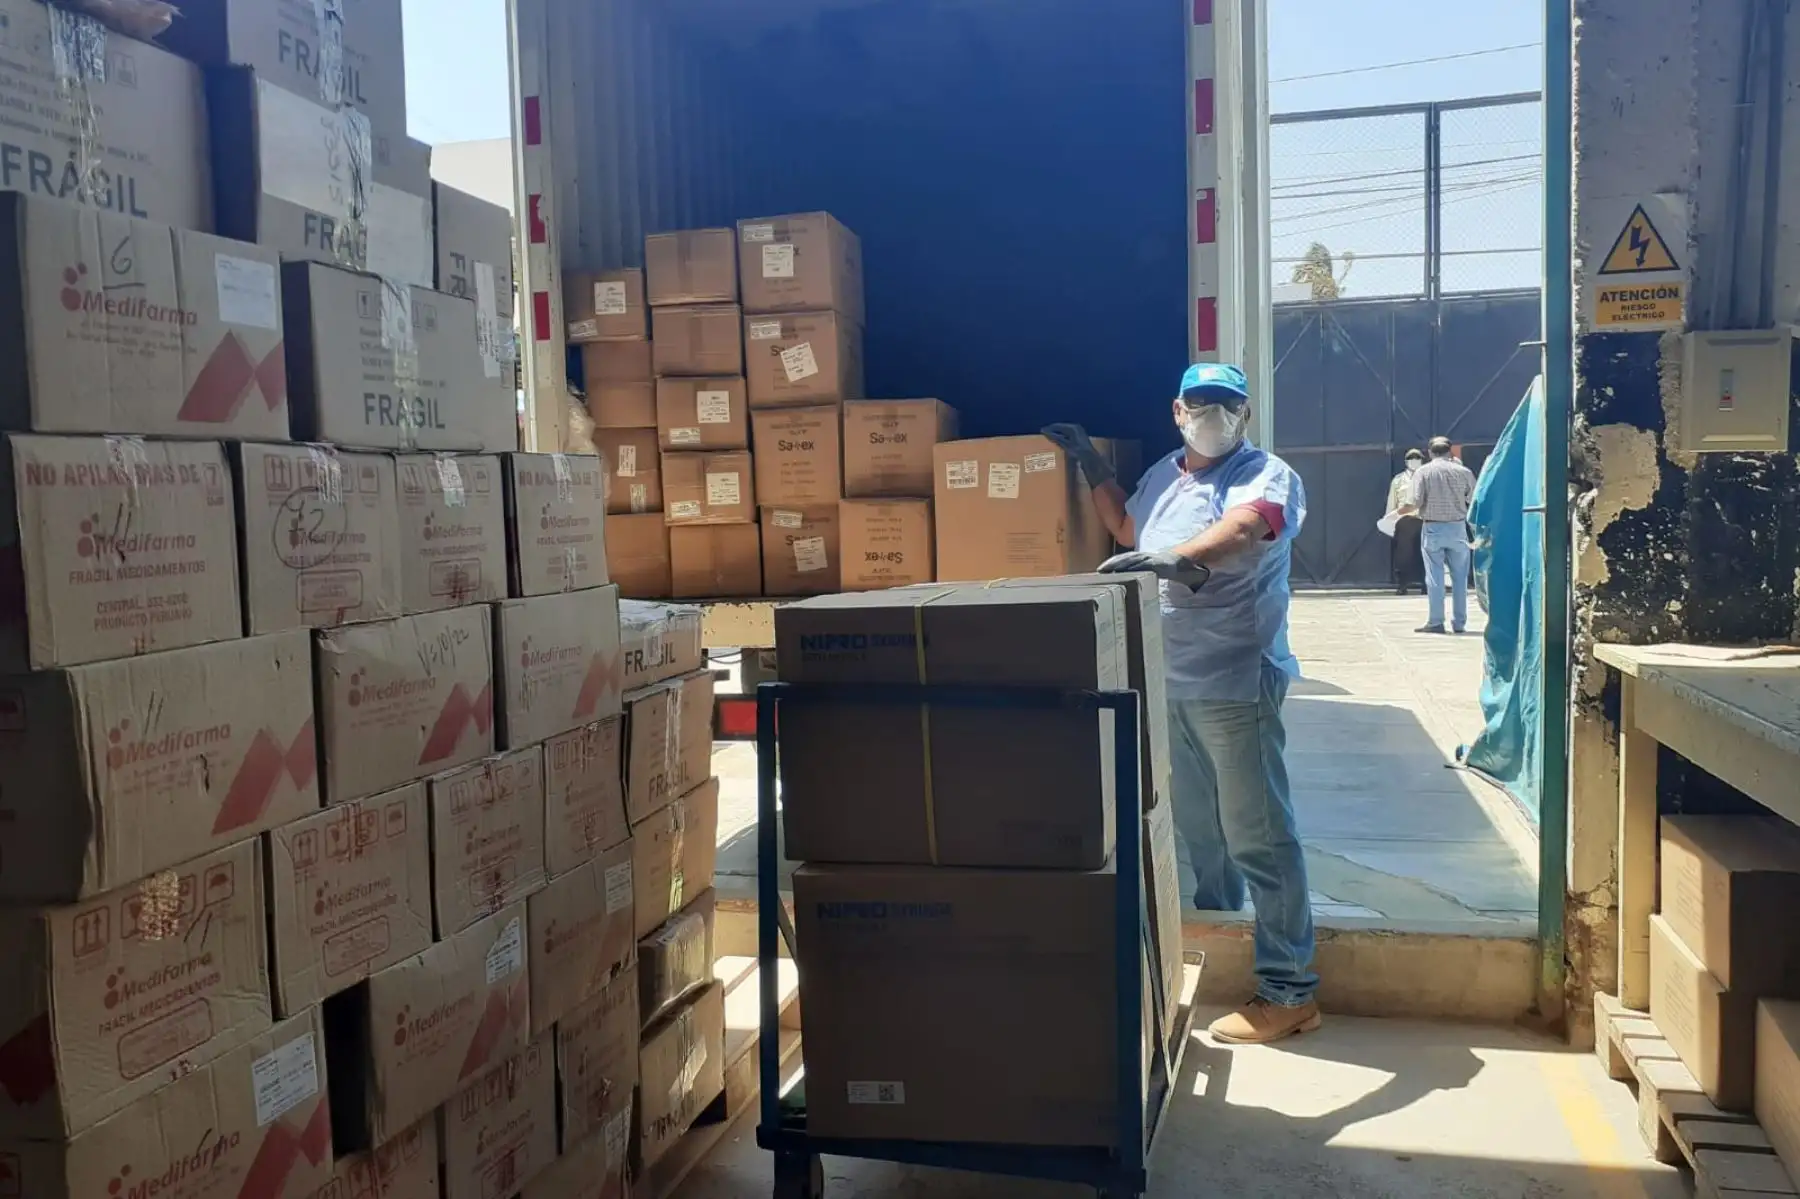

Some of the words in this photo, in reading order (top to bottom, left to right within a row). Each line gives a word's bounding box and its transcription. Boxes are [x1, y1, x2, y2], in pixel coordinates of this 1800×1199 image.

[278, 28, 367, 104] FRIL
[111, 236, 132, 275] 6
[1600, 284, 1679, 303] ATENCIÓN
[83, 290, 197, 326] Medifarma
[1621, 303, 1656, 312] RIESGO
[26, 462, 56, 486] NO
[64, 463, 131, 486] APILA
[180, 464, 200, 484] DE
[205, 466, 218, 486] 7
[93, 533, 196, 557] Medifarma
[69, 569, 113, 585] FRAGIL
[116, 560, 206, 581] MEDICAMENTOS
[801, 633, 867, 651] NIPRO
[624, 641, 676, 676] FRIL
[361, 676, 437, 702] Medifarma
[125, 722, 231, 764] Medifarma
[120, 951, 213, 1004] Medifarma
